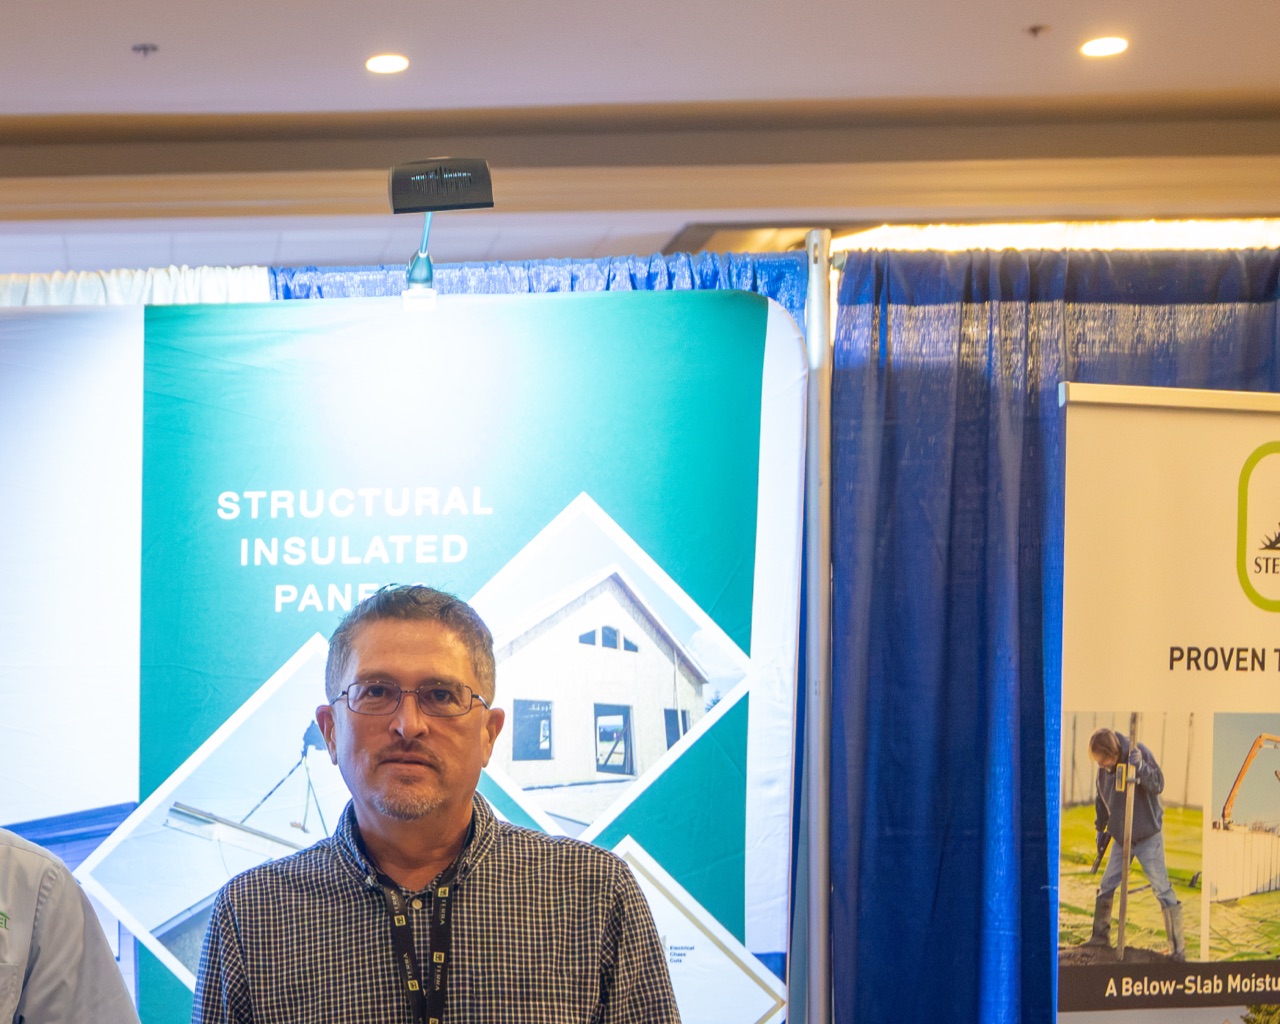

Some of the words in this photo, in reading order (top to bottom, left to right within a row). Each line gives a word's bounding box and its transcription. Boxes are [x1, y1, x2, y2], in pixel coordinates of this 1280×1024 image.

[217, 486, 493, 520] STRUCTURAL
[239, 535, 468, 566] INSULATED
[1169, 646, 1265, 672] PROVEN
[1104, 977, 1117, 997] A
[1122, 974, 1223, 997] Below-Slab
